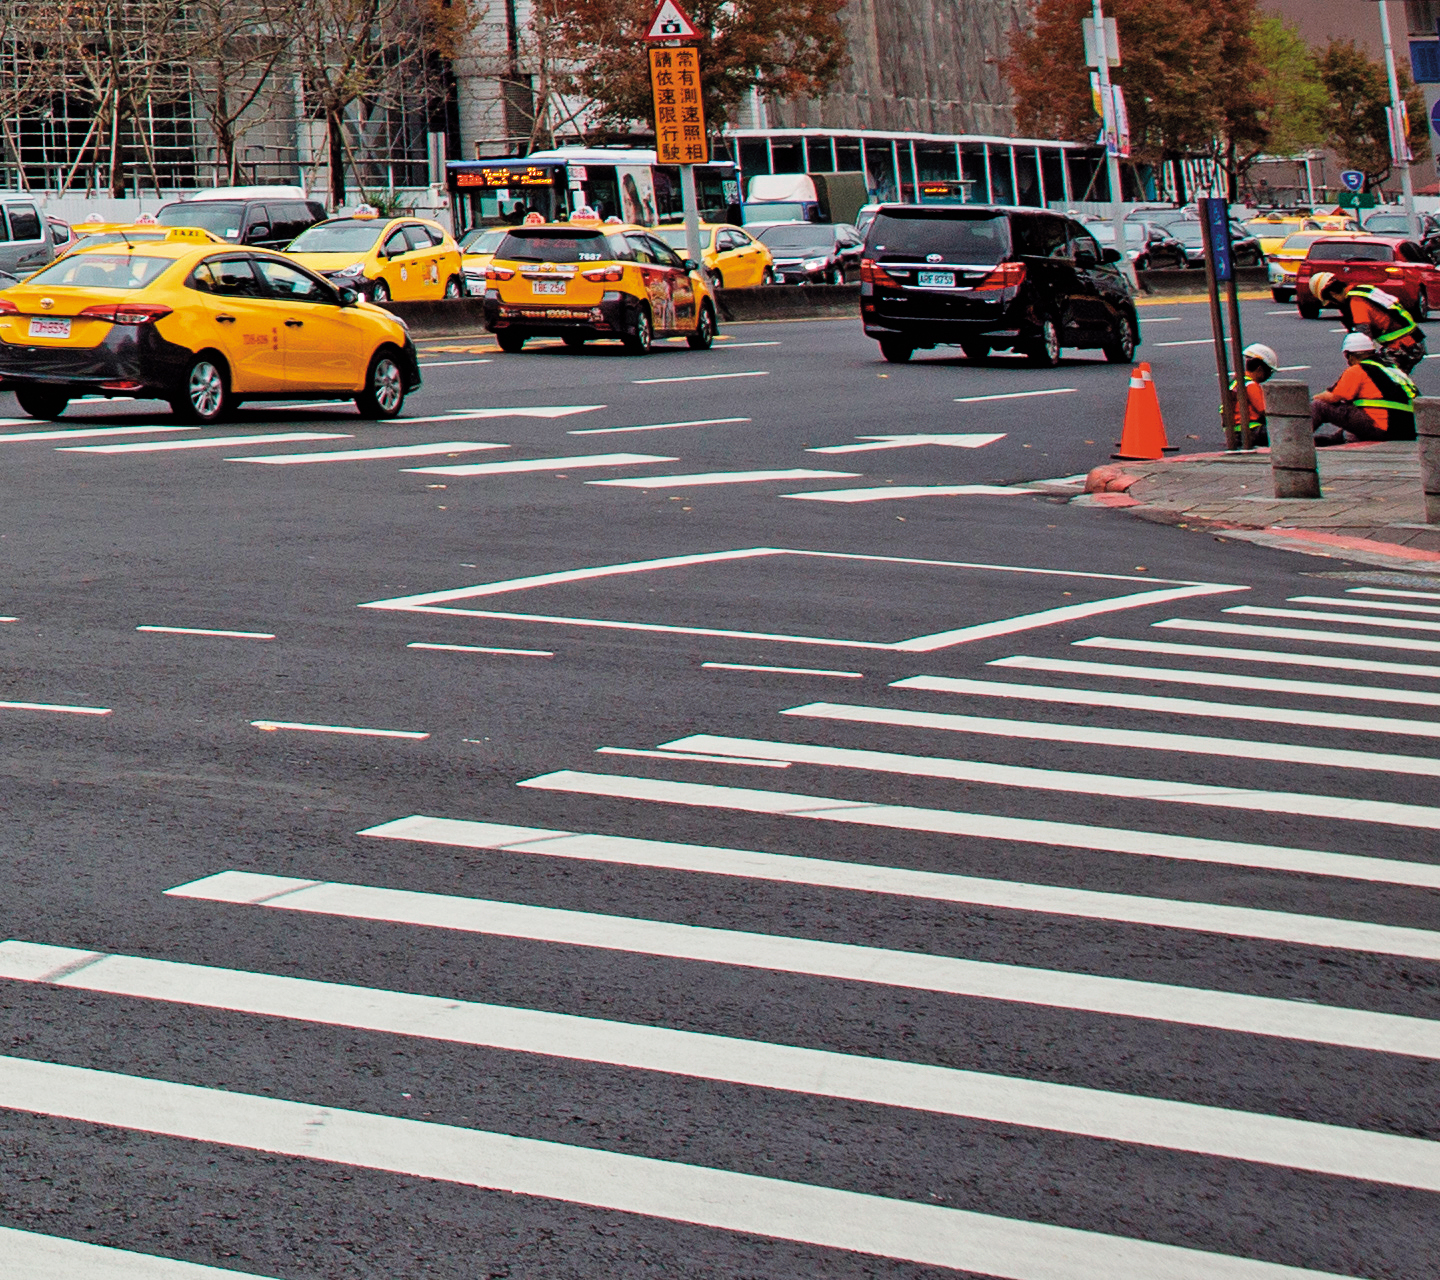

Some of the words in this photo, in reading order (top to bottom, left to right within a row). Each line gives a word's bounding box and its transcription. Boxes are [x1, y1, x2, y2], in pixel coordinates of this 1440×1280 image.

[654, 51, 680, 161] 請依速限行駛
[676, 51, 703, 160] 常有測速照相
[1347, 174, 1358, 185] 5
[1351, 196, 1360, 206] 4
